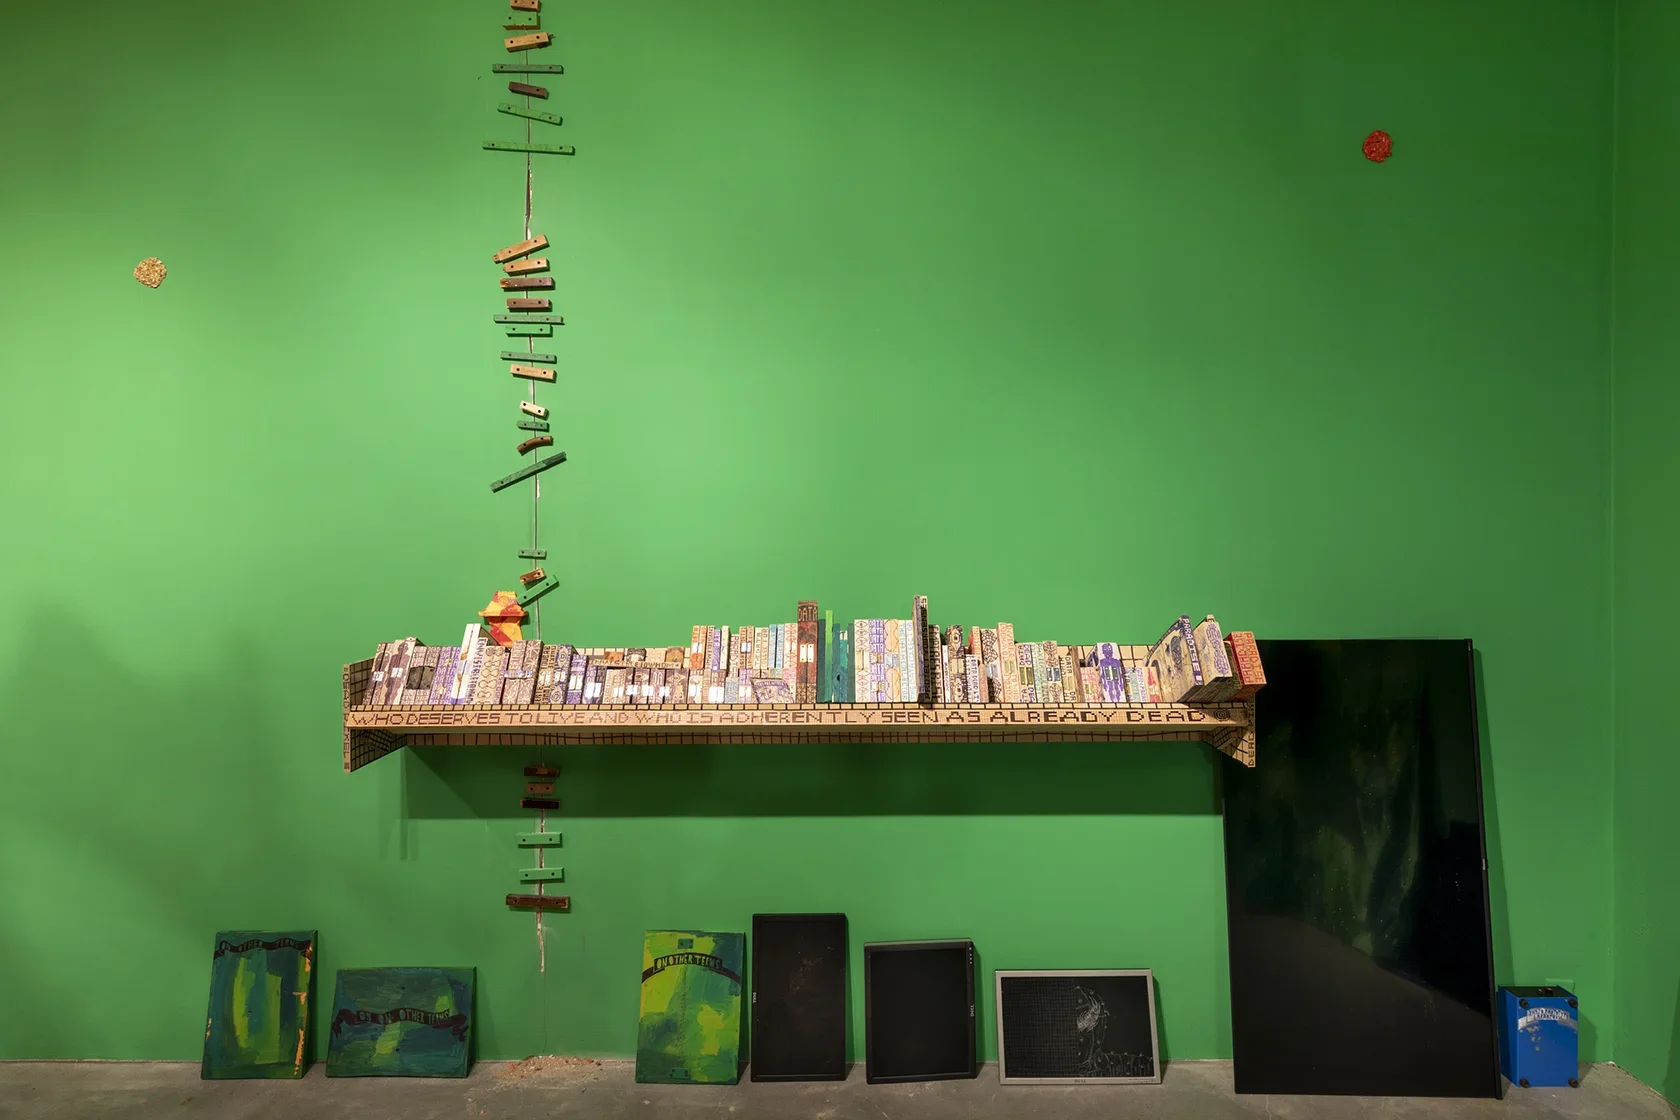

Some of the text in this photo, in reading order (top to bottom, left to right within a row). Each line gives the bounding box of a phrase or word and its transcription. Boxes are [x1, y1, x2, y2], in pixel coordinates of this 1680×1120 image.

[1182, 618, 1200, 672] PARADISE
[1233, 632, 1253, 683] PARADISE
[1244, 632, 1265, 683] PARADISE
[351, 711, 1206, 725] WHO DESERVES TO LIVE AND WHO IS ADHERENTLY SEEN AS ALREADY DEAD
[1247, 731, 1255, 766] DEAD
[221, 938, 300, 952] ON OTHER TERMS
[656, 954, 720, 970] ON OTHER TERMS
[399, 1009, 425, 1024] OTHER
[428, 1011, 449, 1025] TERMS
